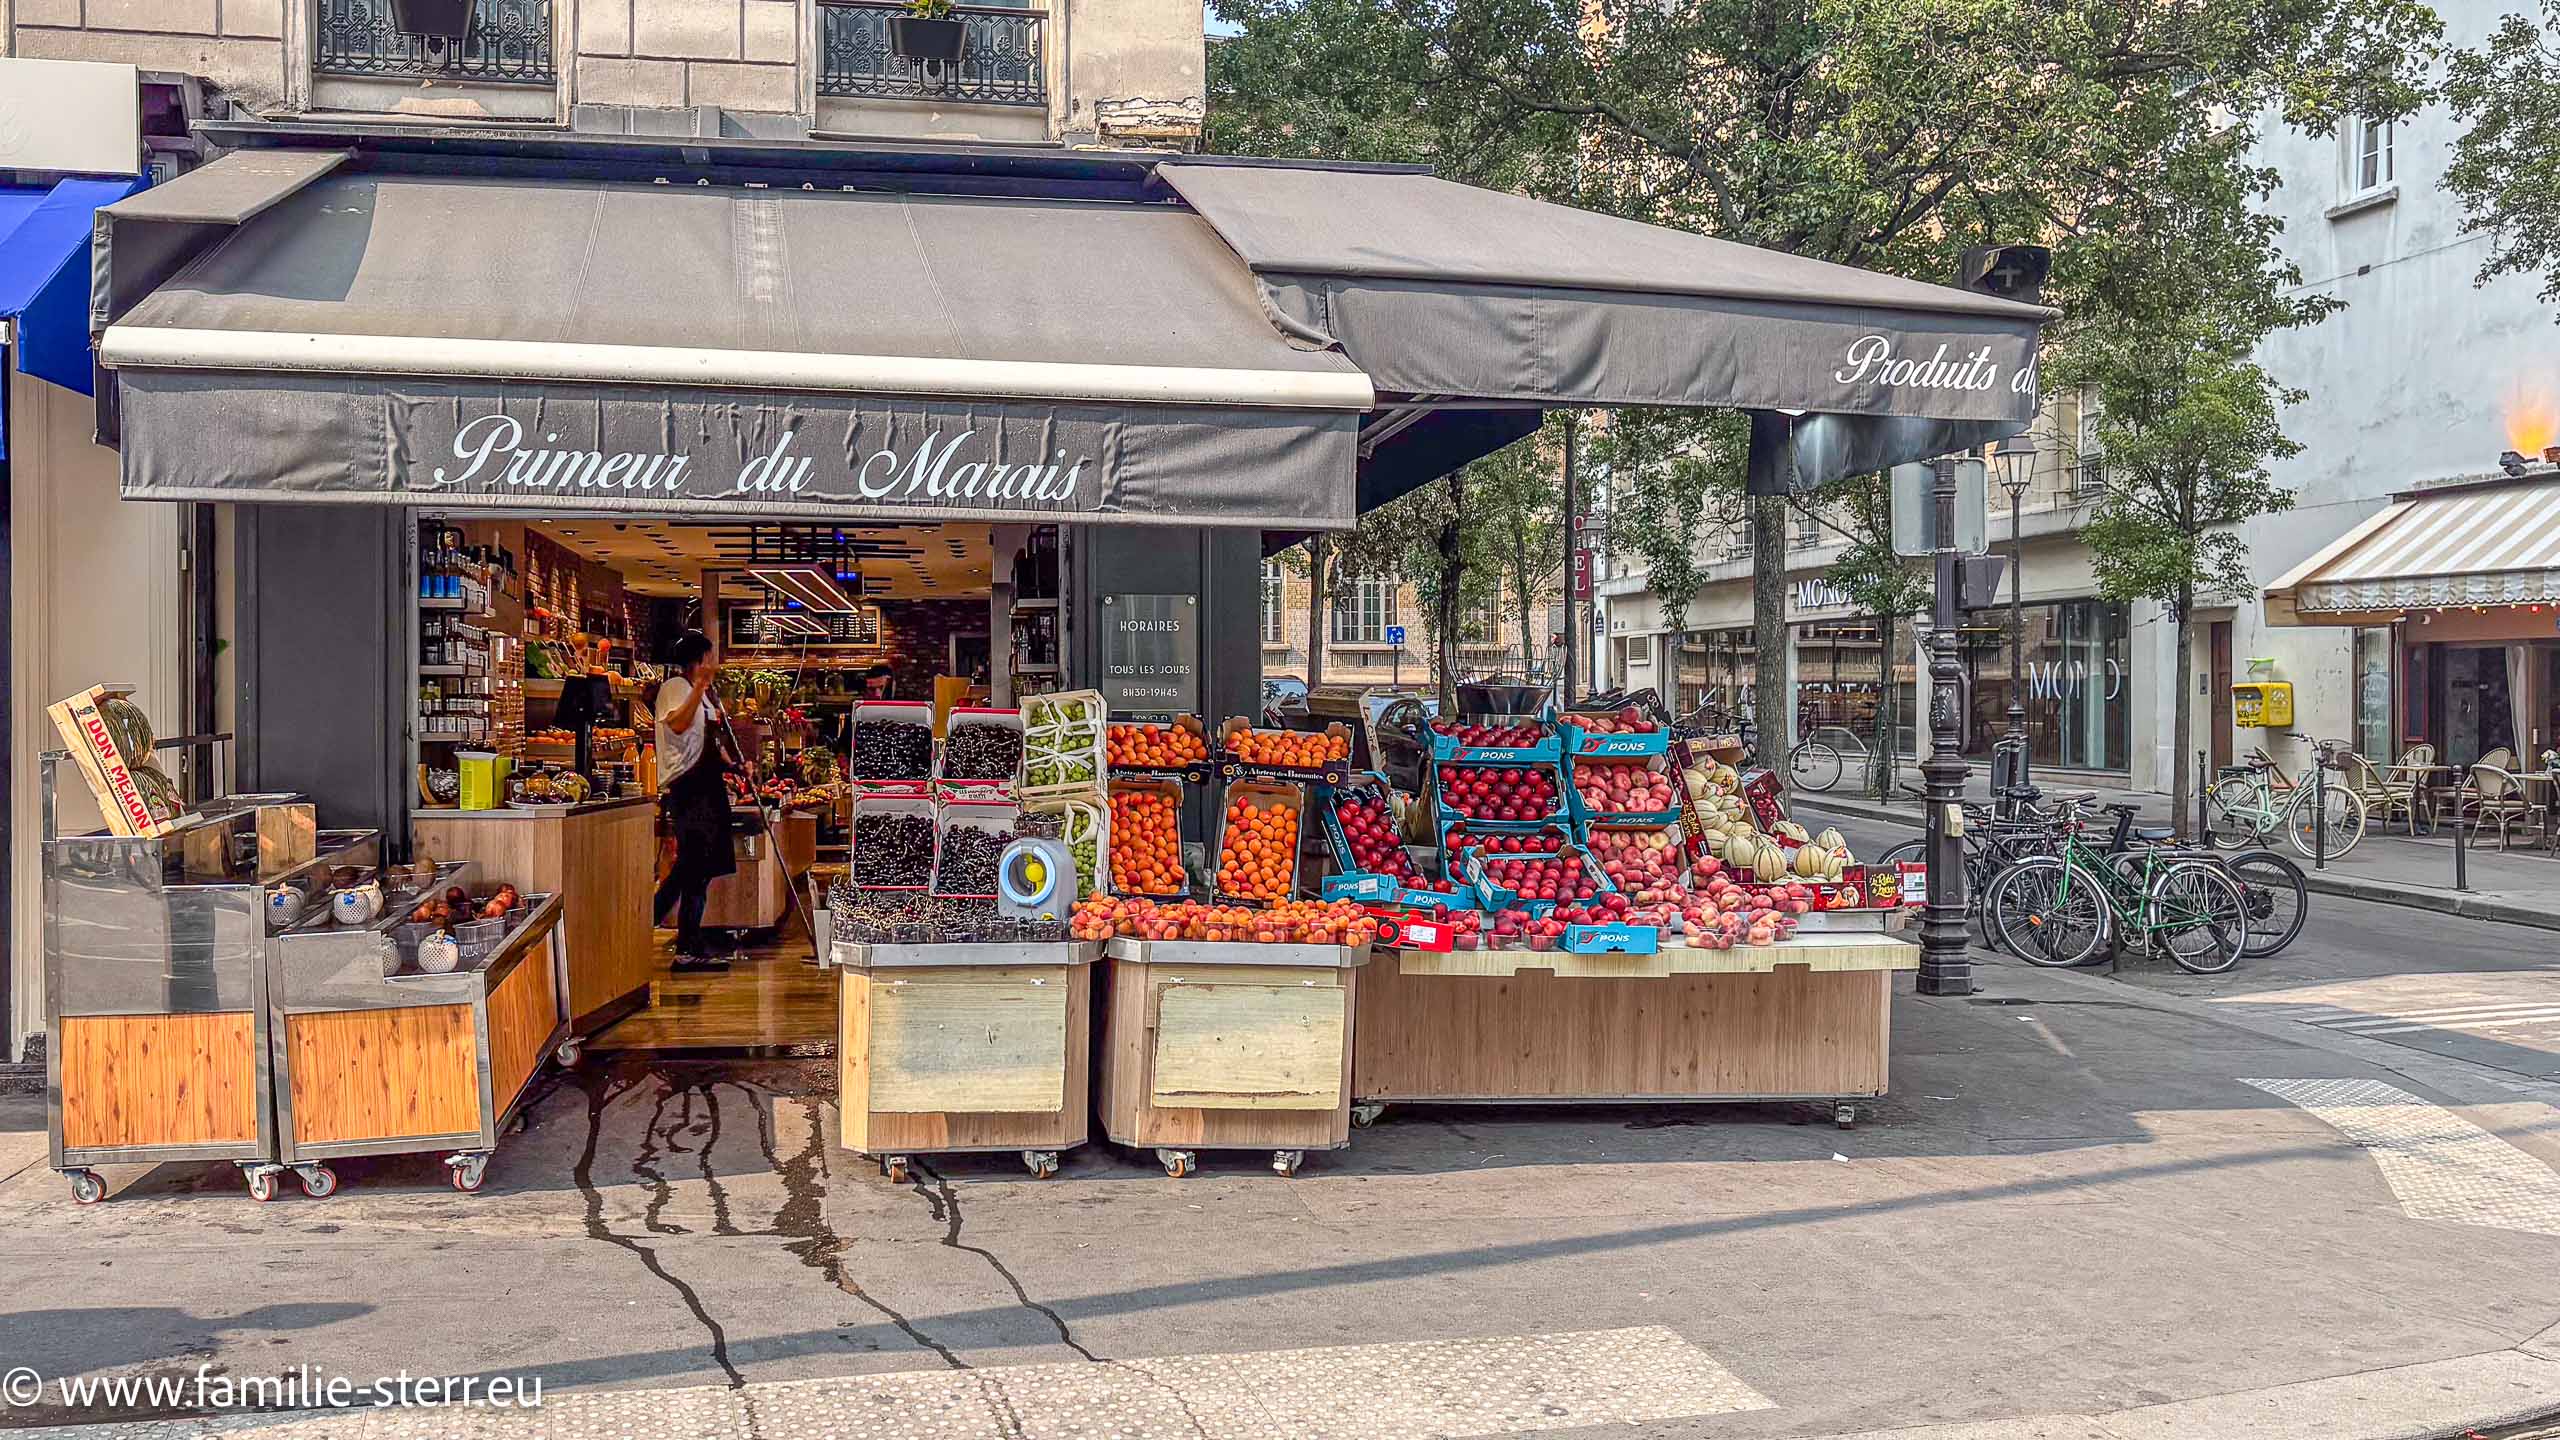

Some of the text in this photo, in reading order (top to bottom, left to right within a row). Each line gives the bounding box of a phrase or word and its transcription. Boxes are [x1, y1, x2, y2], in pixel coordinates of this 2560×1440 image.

[1835, 335, 1998, 391] Produits
[433, 414, 1084, 500] Primeur du Marais
[1119, 620, 1180, 632] HORAIRES
[1109, 665, 1190, 674] TOUS LES JOURS
[1122, 687, 1178, 697] 8H30-19H45
[1607, 742, 1646, 752] PONS
[1480, 751, 1516, 760] PONS
[87, 718, 116, 760] DON
[111, 765, 151, 830] MELON
[1329, 823, 1346, 855] PONS
[1338, 882, 1359, 891] PONS
[1414, 895, 1441, 904] PONS
[1599, 934, 1630, 942] PONS
